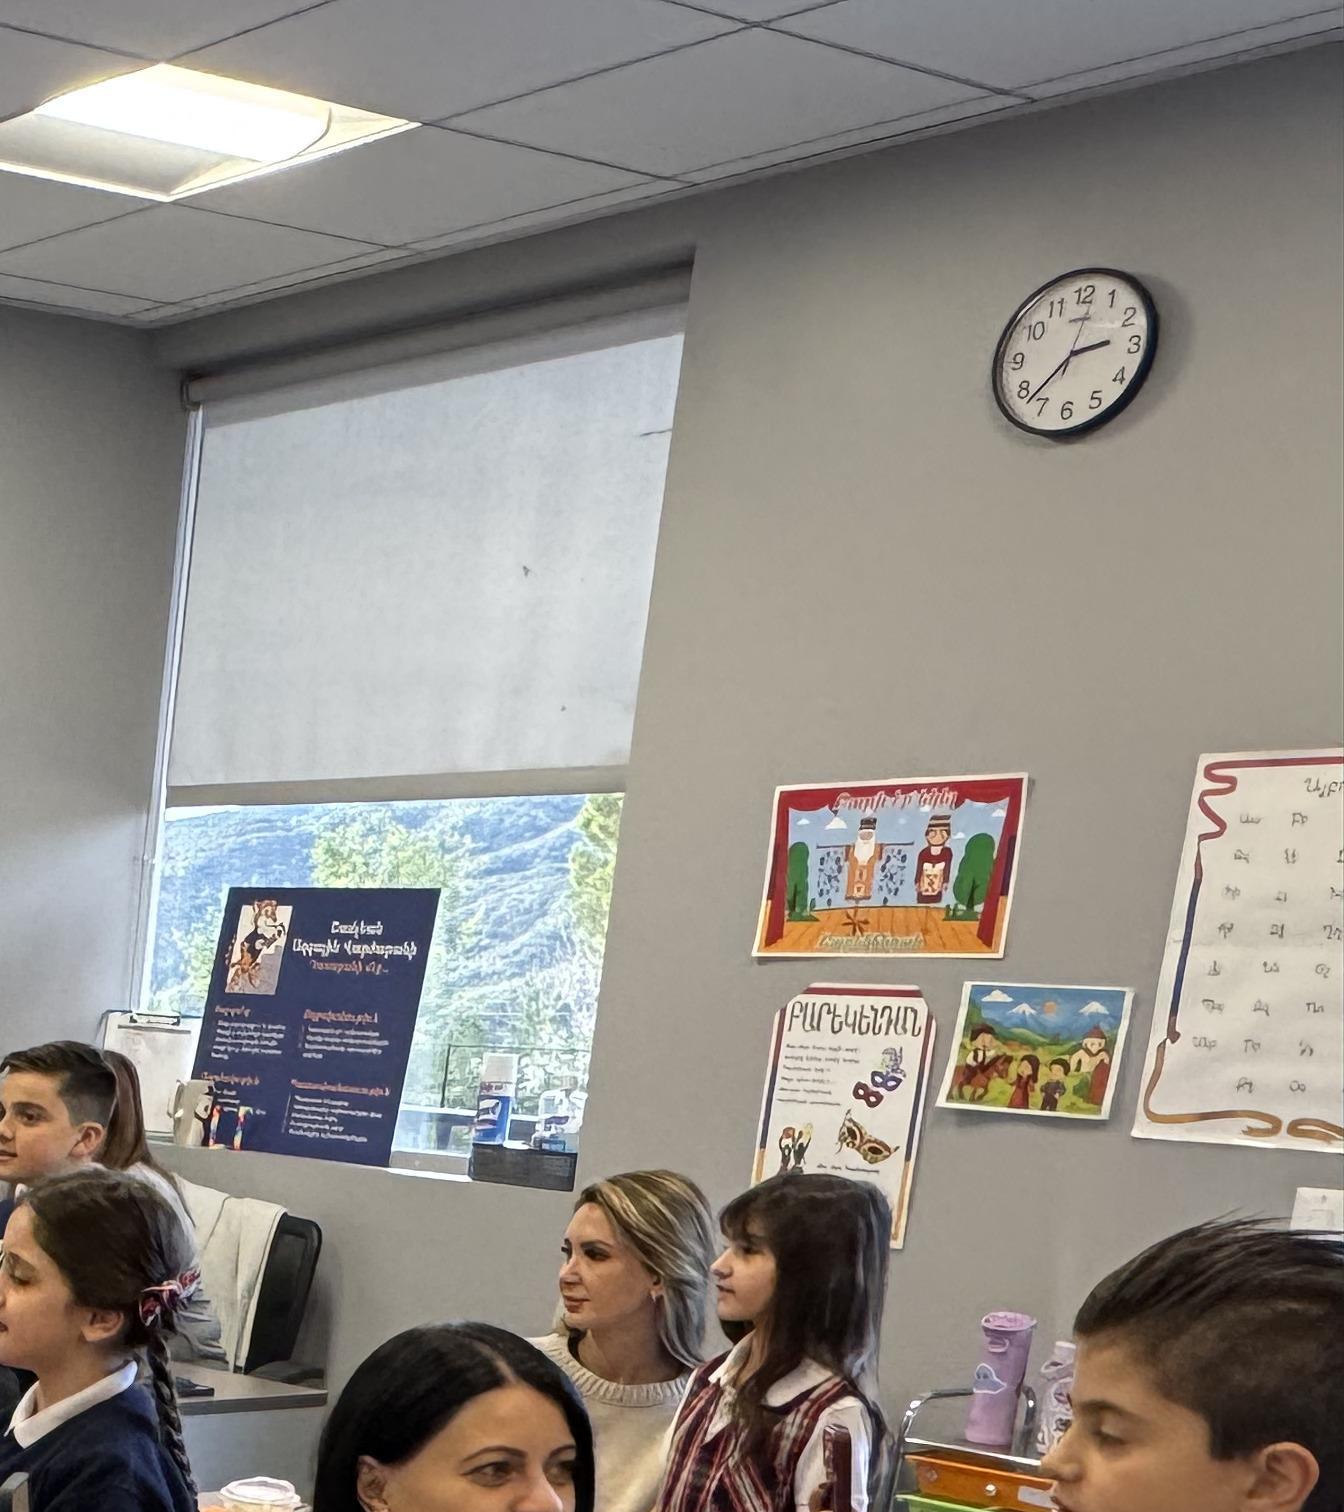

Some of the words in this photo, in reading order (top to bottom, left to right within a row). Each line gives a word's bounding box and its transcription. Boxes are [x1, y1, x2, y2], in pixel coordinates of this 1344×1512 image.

[1073, 284, 1096, 305] 12
[1108, 289, 1119, 308] 1
[1048, 298, 1065, 318] 11
[1121, 307, 1137, 327] 2
[1027, 321, 1045, 341] 10
[1127, 335, 1141, 354] 3
[1010, 353, 1025, 370] 9
[1112, 366, 1126, 385] 4
[1017, 380, 1030, 400] 8
[1088, 390, 1103, 409] 5
[1036, 397, 1050, 417] 7
[1060, 401, 1073, 420] 6
